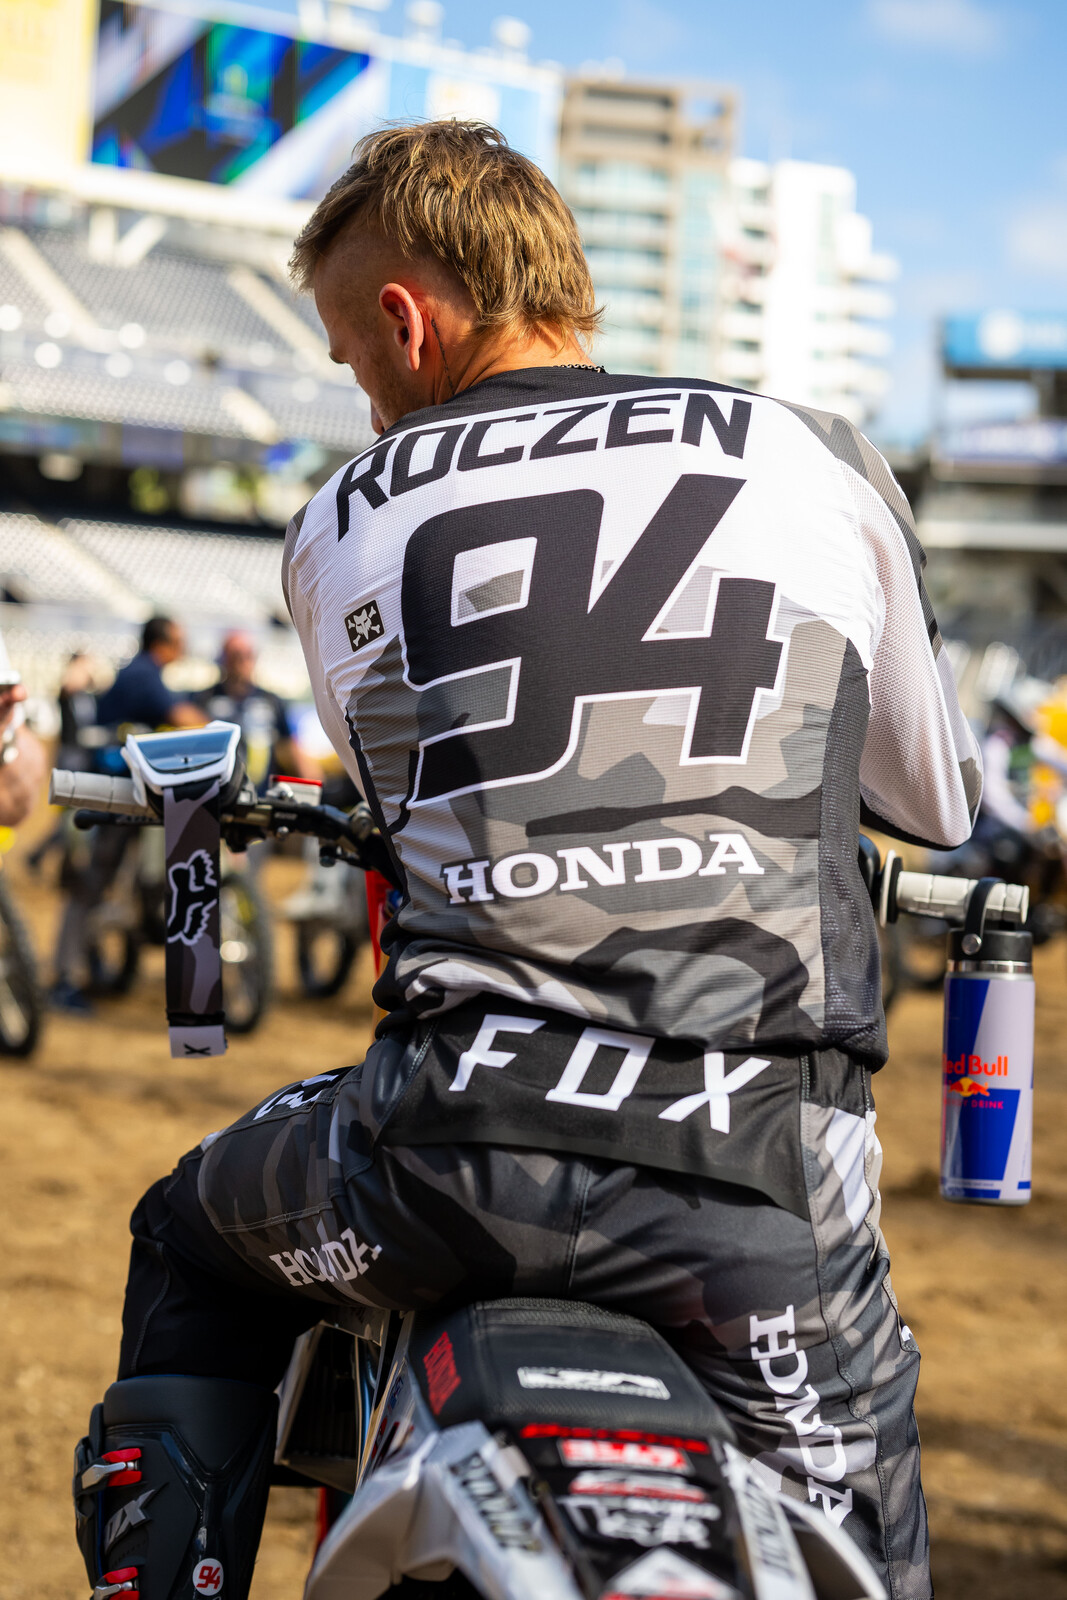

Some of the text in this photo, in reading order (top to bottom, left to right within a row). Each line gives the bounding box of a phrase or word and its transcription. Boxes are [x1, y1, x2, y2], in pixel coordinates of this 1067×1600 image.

[336, 392, 752, 542] ROCZEN
[400, 473, 788, 806] 94
[443, 833, 765, 904] HONDA
[448, 1013, 773, 1134] FOX
[967, 1054, 1009, 1077] Bull
[750, 1304, 853, 1529] HONDA
[196, 1565, 221, 1590] 94
